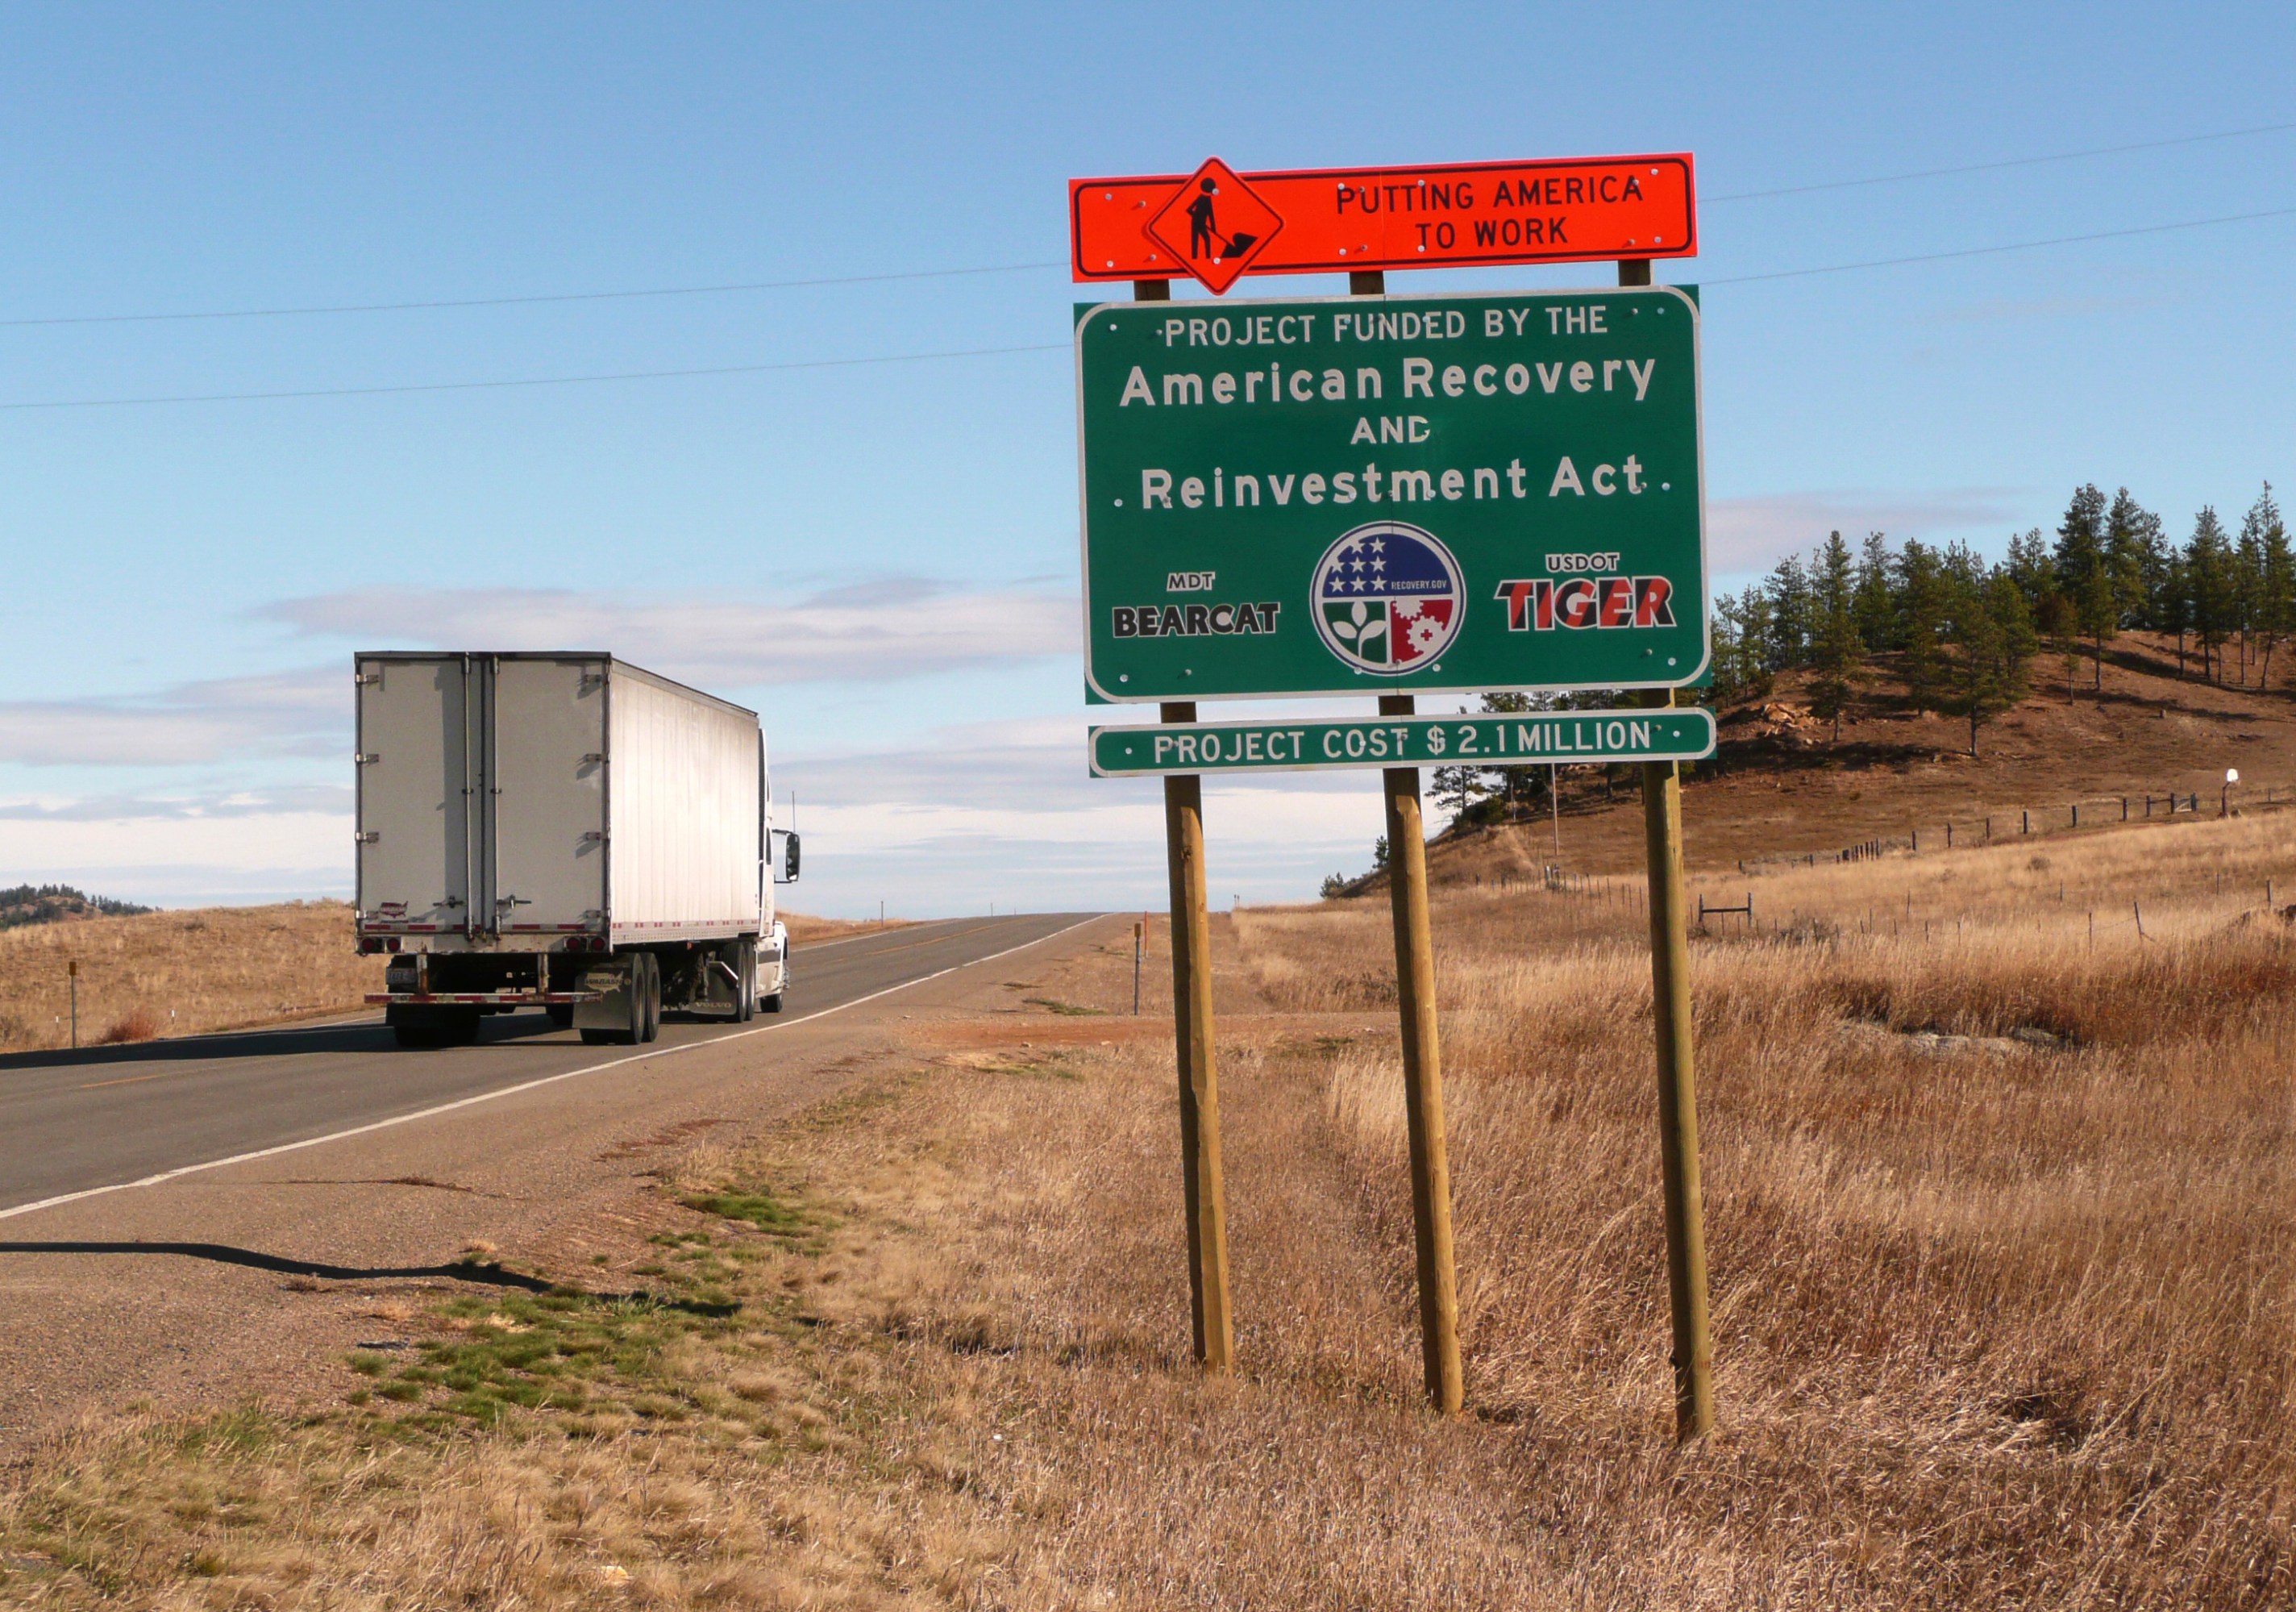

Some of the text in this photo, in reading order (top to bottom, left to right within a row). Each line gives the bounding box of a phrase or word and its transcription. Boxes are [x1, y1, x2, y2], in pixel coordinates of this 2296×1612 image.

[1337, 175, 1643, 215] PUTTING AMERICA
[1416, 217, 1568, 250] TO WORK
[1165, 306, 1608, 347] PROJECT FUNDED BY THE
[1120, 357, 1655, 406] American Recovery
[1350, 415, 1431, 444] AND
[1142, 458, 1526, 509] Reinvestment
[1545, 552, 1620, 573] USDOT
[1167, 572, 1216, 592] MDT
[1391, 580, 1447, 590] RECOVERY.GOV
[1113, 602, 1280, 638] BEARCAT
[1493, 576, 1677, 632] TIGER
[1154, 731, 1305, 763] PROJECT
[1323, 728, 1408, 758] COST
